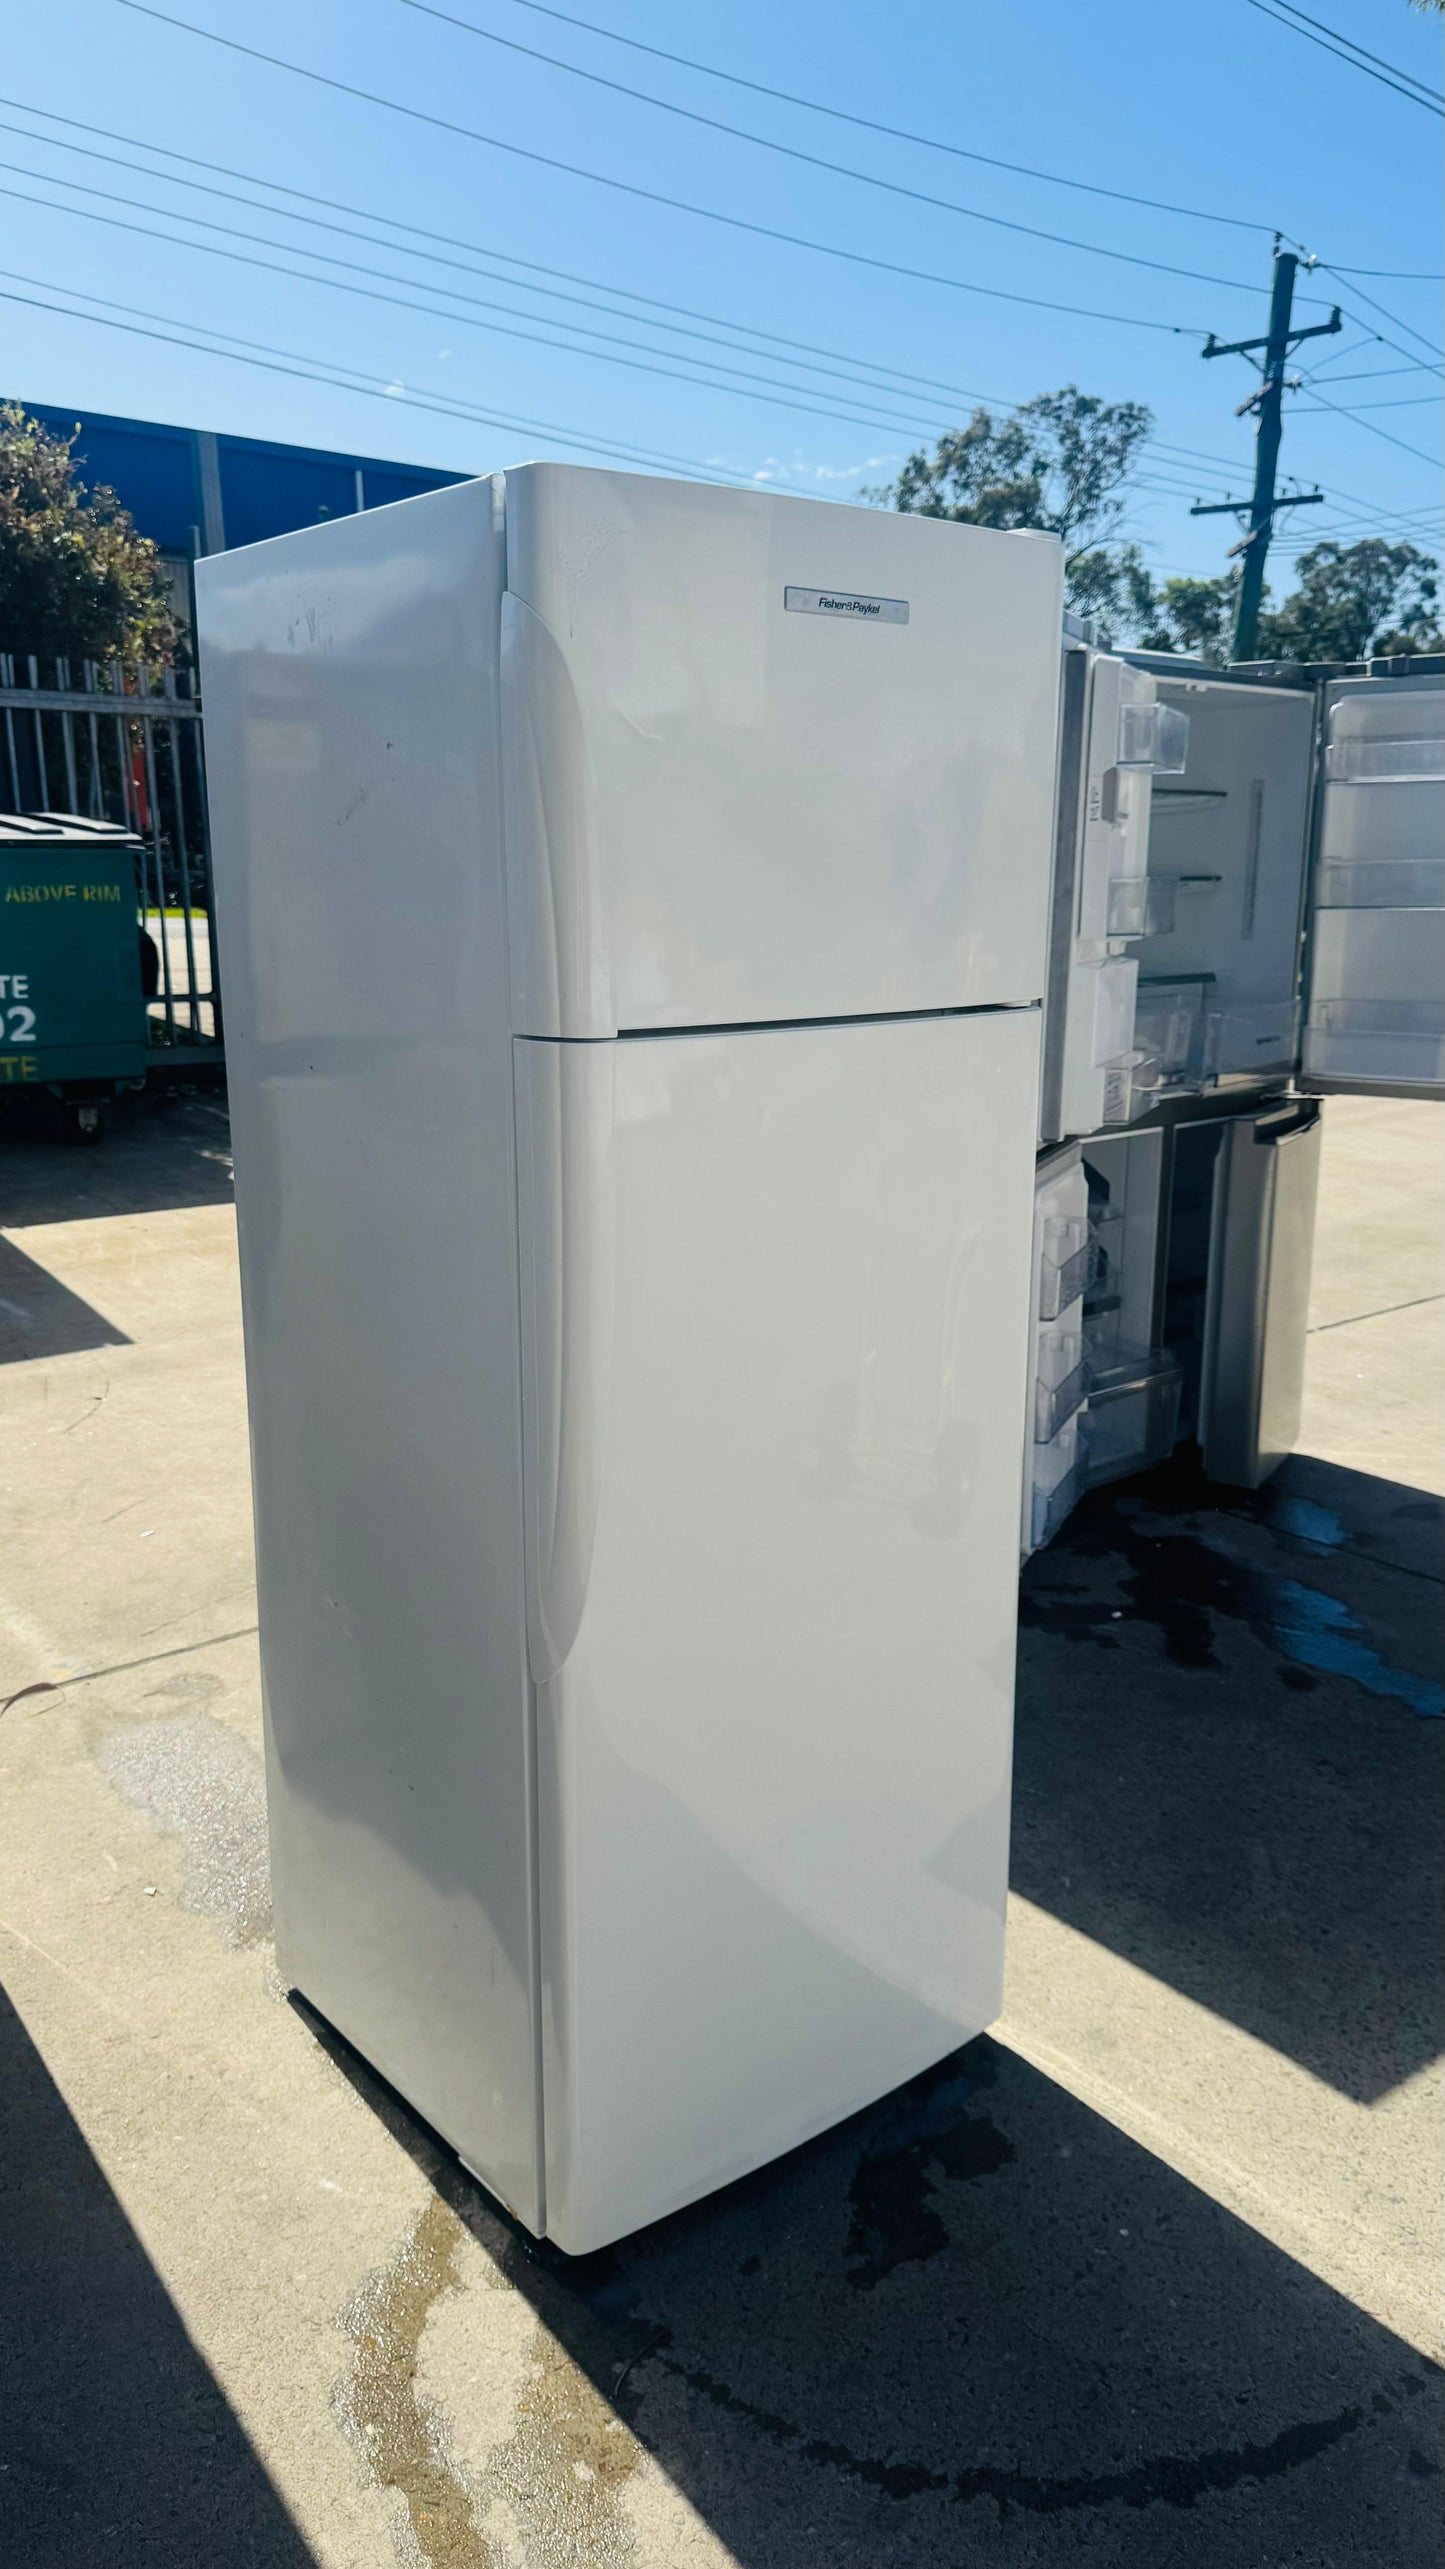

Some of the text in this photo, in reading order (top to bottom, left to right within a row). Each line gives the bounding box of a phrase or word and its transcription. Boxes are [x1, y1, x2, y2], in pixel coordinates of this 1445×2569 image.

[818, 597, 881, 615] Fisher&Paykel
[5, 884, 121, 902] ABOVE RIM
